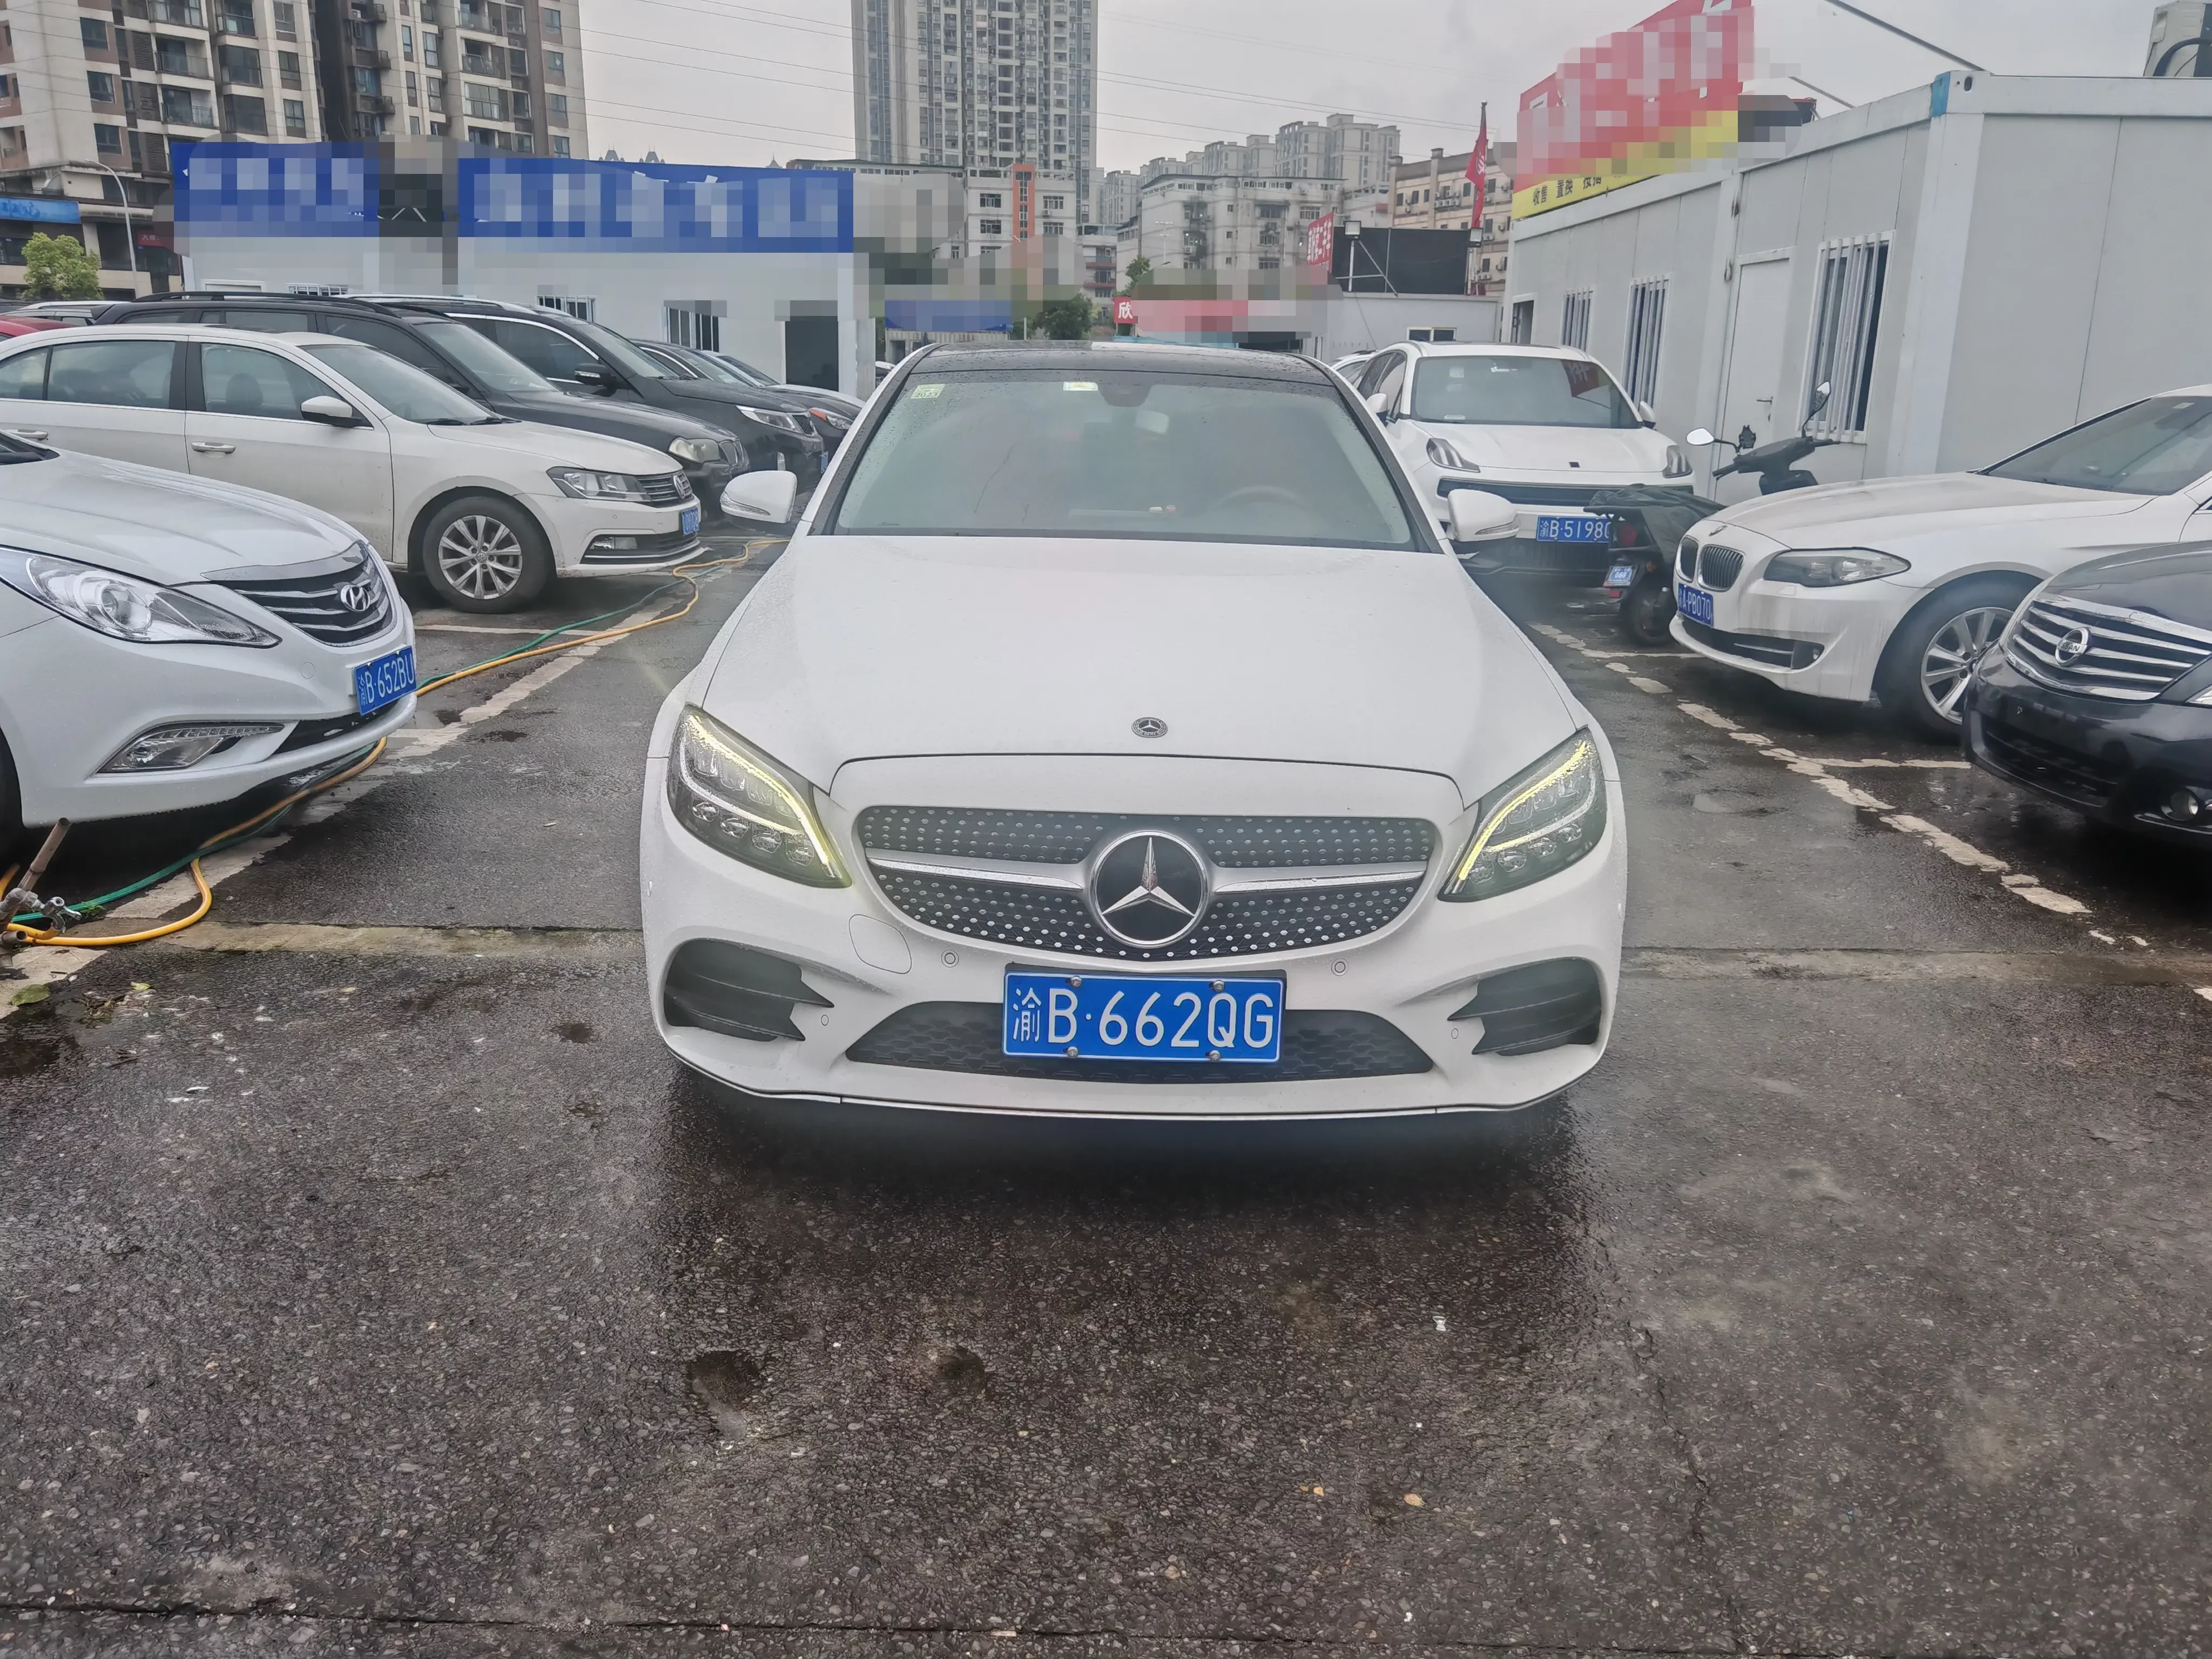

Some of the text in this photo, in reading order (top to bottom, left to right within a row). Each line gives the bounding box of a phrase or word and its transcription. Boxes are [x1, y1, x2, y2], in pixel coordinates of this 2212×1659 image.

[1118, 301, 1134, 320] 欣
[358, 652, 415, 706] 渝B·652BU
[1012, 987, 1274, 1048] 渝B·662QG
